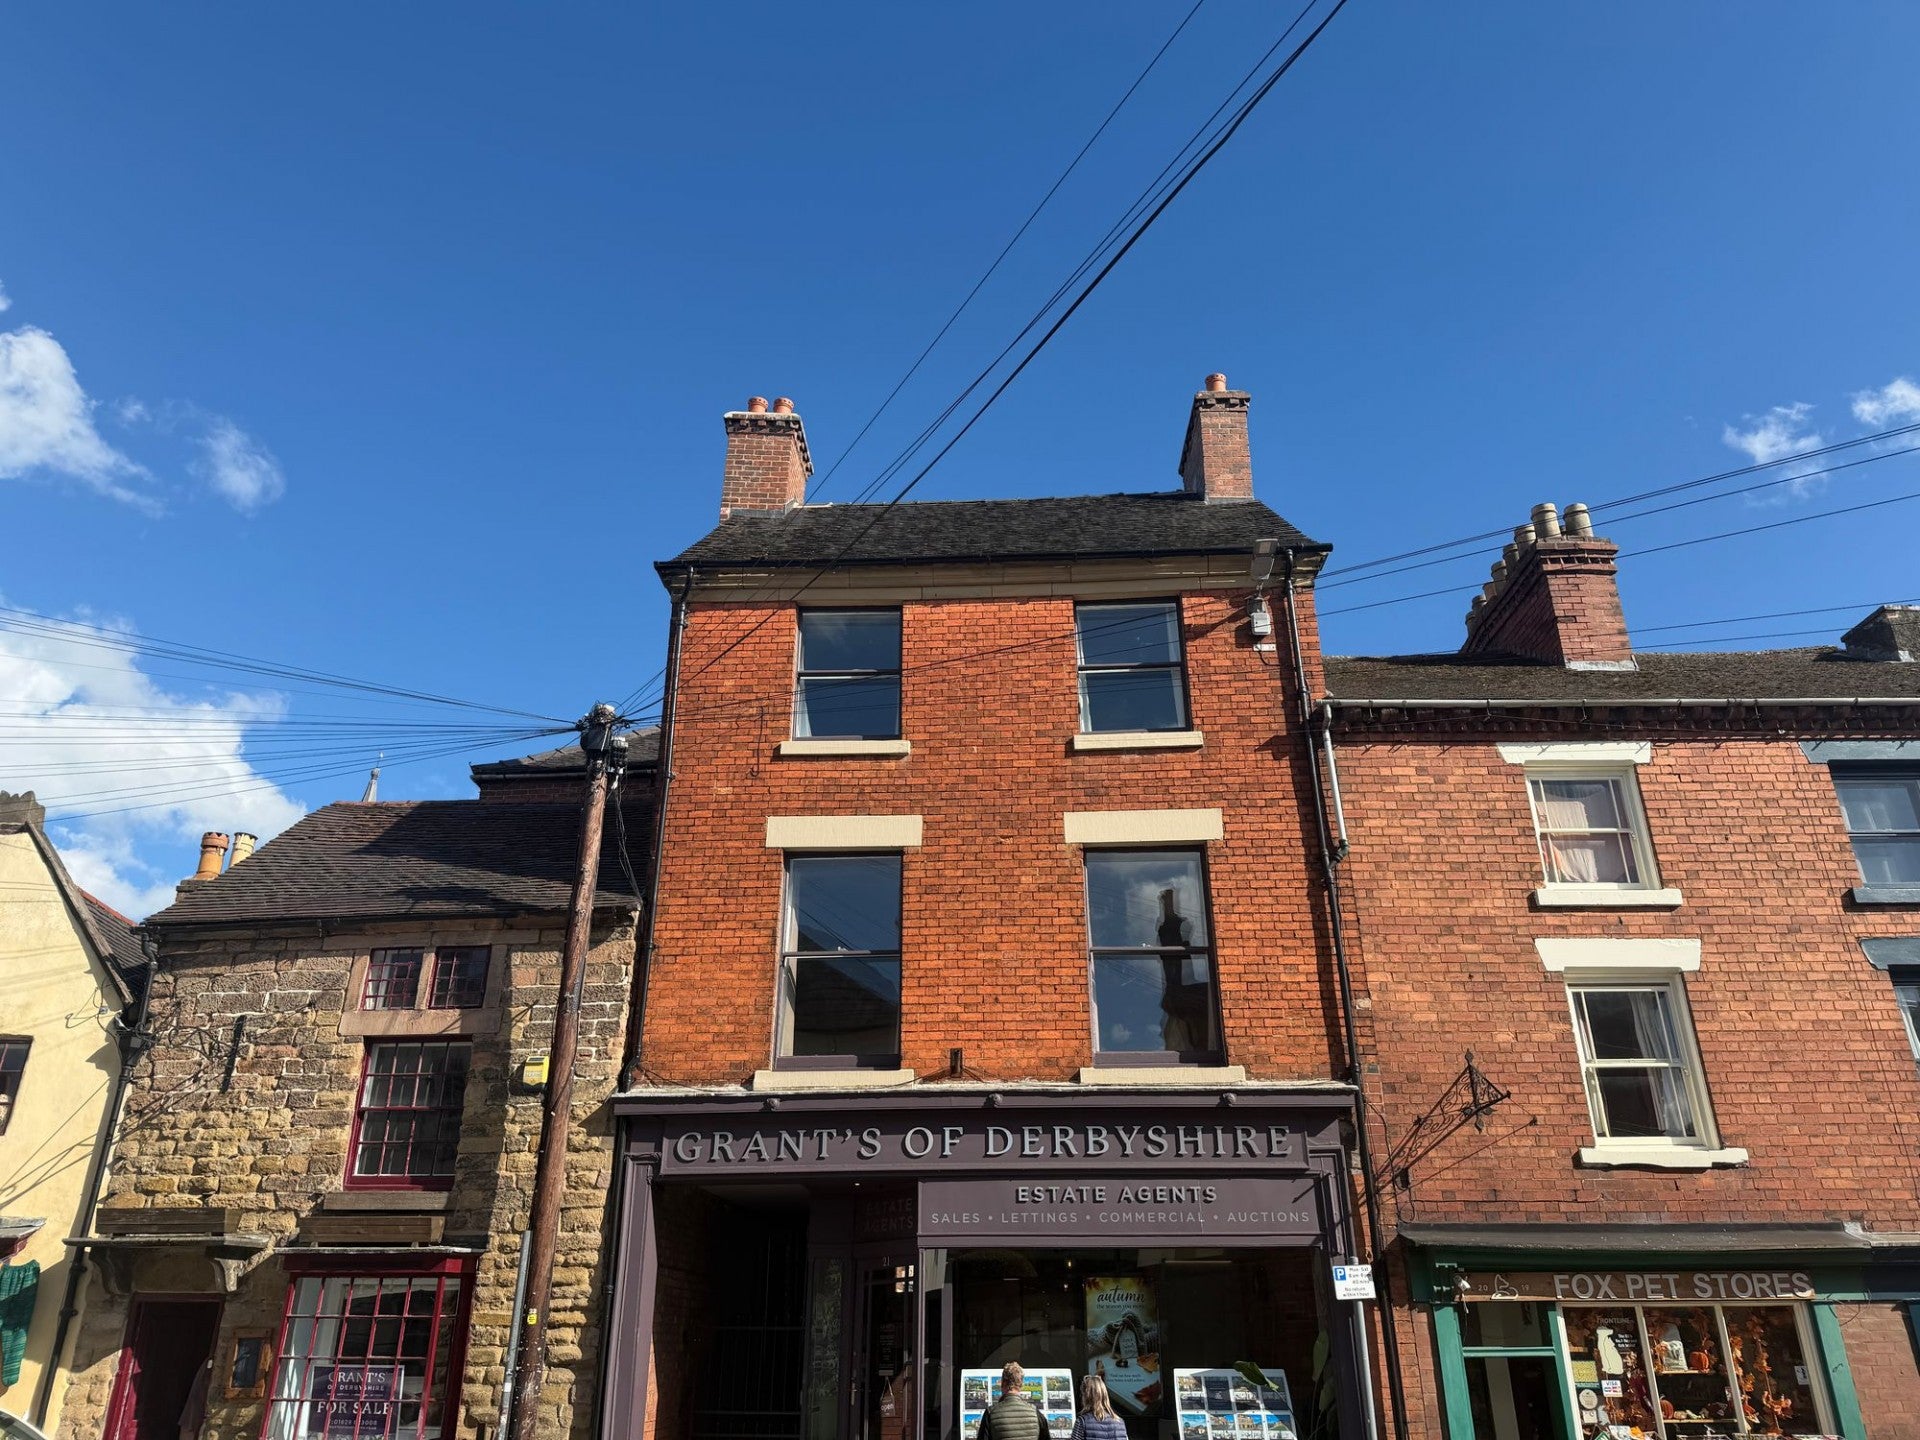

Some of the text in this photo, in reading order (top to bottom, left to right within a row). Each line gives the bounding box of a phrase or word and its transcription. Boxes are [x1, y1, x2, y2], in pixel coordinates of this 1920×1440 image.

[677, 1125, 1290, 1162] GRANT'S OF DERBYSHIRE
[1017, 1186, 1218, 1204] ESTATE AGENTS
[931, 1211, 1311, 1225] SALES LETTINGS COMMERCIAL AUCTIONS
[882, 1255, 890, 1267] 21
[1478, 1284, 1488, 1292] 20
[1553, 1272, 1815, 1299] FOX PET STORES
[1097, 1284, 1145, 1304] autumn
[1597, 1317, 1630, 1325] FRONTLINE
[317, 1401, 347, 1414] FOR
